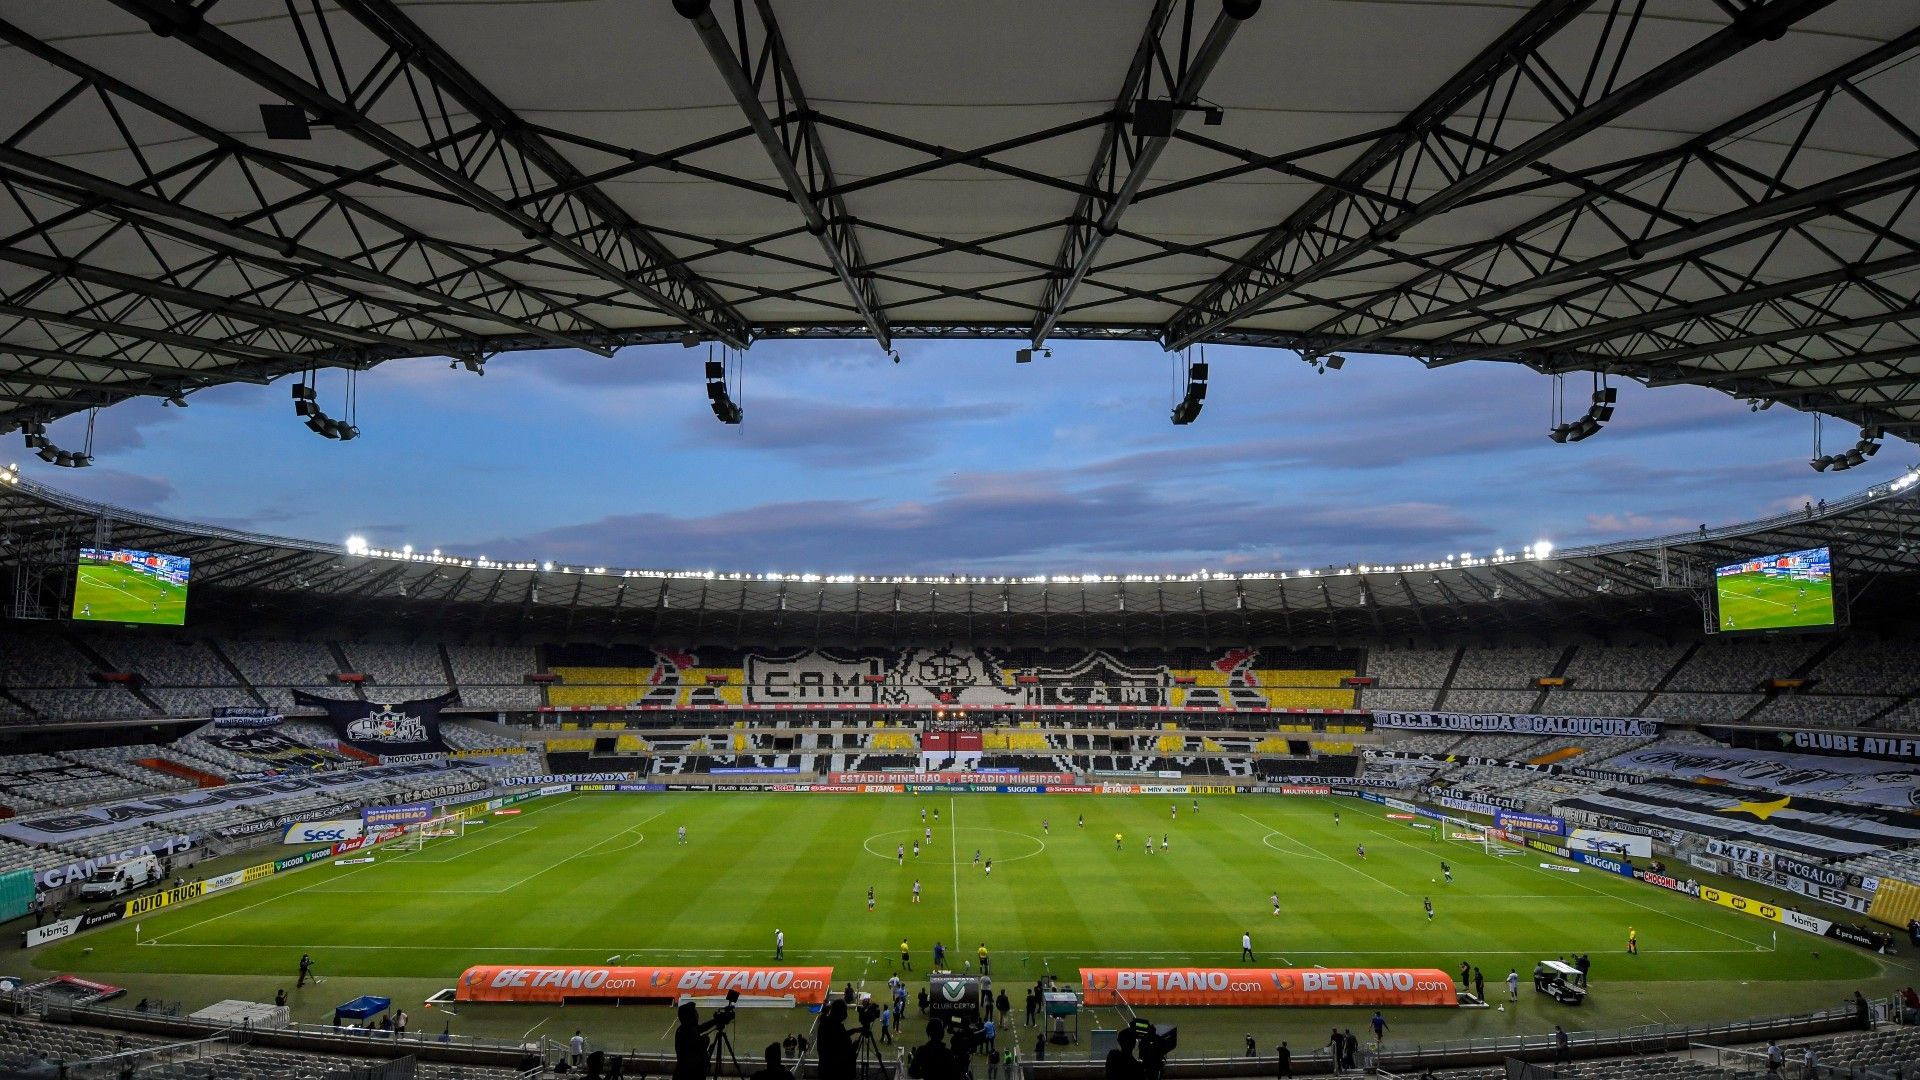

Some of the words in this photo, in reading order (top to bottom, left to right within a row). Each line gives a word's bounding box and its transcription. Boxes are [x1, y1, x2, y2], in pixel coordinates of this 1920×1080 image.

[765, 671, 860, 697] CAM
[1389, 714, 1437, 727] G.C.R.
[1440, 714, 1513, 730] TORCIDA
[1533, 717, 1641, 736] GALOUCURA
[1795, 732, 1859, 752] CLUBE
[387, 754, 434, 763] MOTOGALO
[504, 773, 626, 786] UNIFORMIZADA
[840, 773, 884, 783] ESTÁDIO
[1351, 778, 1397, 788] JOVEM
[304, 829, 345, 841] Sesc
[163, 835, 192, 855] 13
[282, 856, 304, 869] SICOOB
[311, 849, 331, 860] SICOOB
[1584, 854, 1621, 873] SUGGAR
[1787, 861, 1835, 884] PCGALO
[1643, 871, 1677, 890] CHOCOMIL
[1677, 880, 1700, 897] BLAK
[132, 895, 163, 914] AUTO
[167, 883, 202, 902] TRUCK
[1707, 891, 1718, 901] BH
[1733, 897, 1745, 908] BH
[1761, 907, 1775, 917] BH
[47, 923, 69, 937] bmg
[1798, 916, 1818, 932] bmg
[1842, 932, 1853, 941] pra
[1853, 934, 1872, 945] mim.
[490, 968, 636, 990] BETANO.com
[677, 969, 823, 991] BETANO.com
[1116, 971, 1262, 993] BETANO.com
[1303, 972, 1448, 993] BETANO.com
